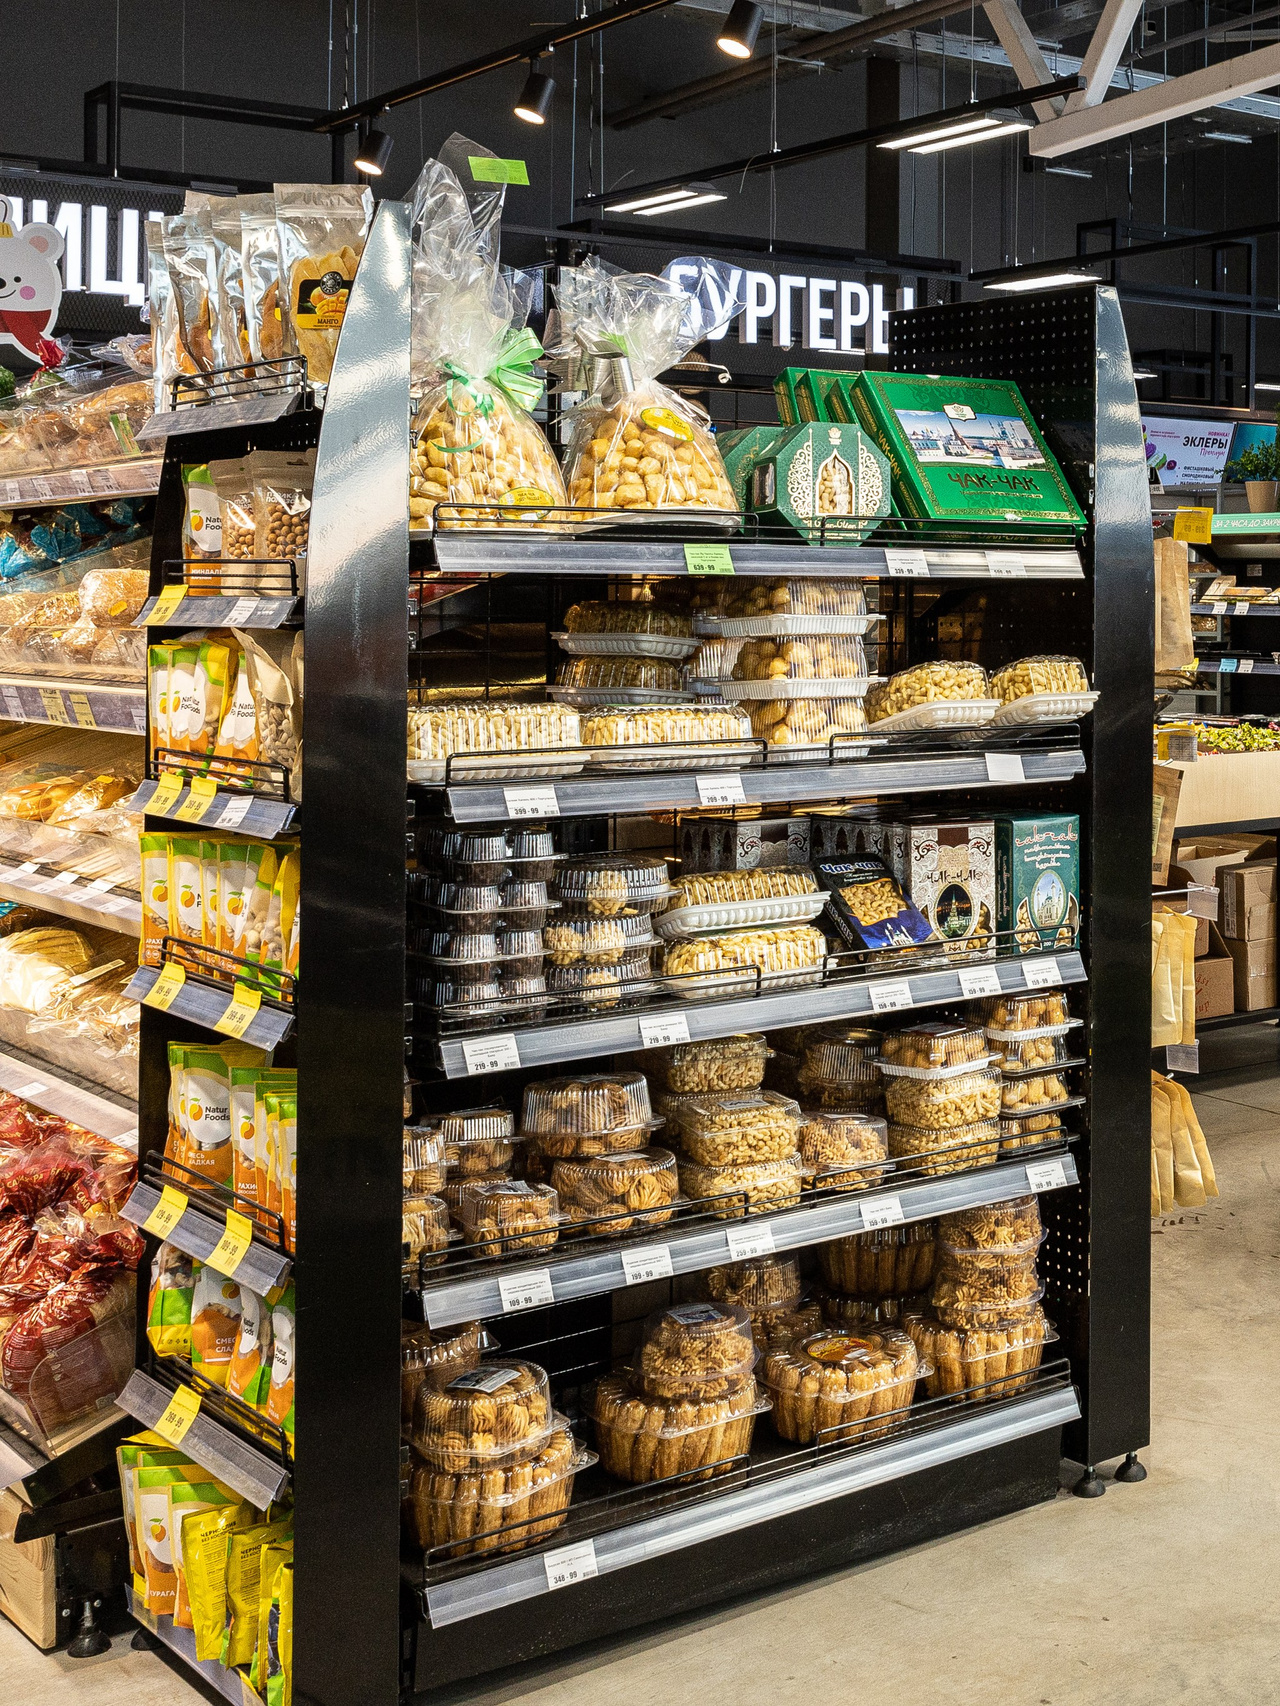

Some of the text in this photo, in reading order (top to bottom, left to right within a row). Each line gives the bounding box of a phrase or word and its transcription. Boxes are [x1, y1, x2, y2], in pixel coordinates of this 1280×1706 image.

[5, 195, 165, 307] ИЦ
[1182, 435, 1229, 450] ЭКЛЕРЫ
[947, 470, 1041, 493] ЧАК-ЧАК
[820, 861, 885, 874] Чак-чак
[926, 868, 983, 884] ЧАК-ЧАК
[474, 1060, 499, 1071] 219-99
[204, 1105, 228, 1114] Natur
[204, 1113, 231, 1122] Foods
[238, 1182, 258, 1190] РАХИ
[736, 1246, 758, 1257] 259-99
[631, 1269, 654, 1281] 199-99
[509, 1295, 533, 1307] 109-99
[165, 1410, 184, 1429] 269-99
[553, 1570, 578, 1584] 348-99
